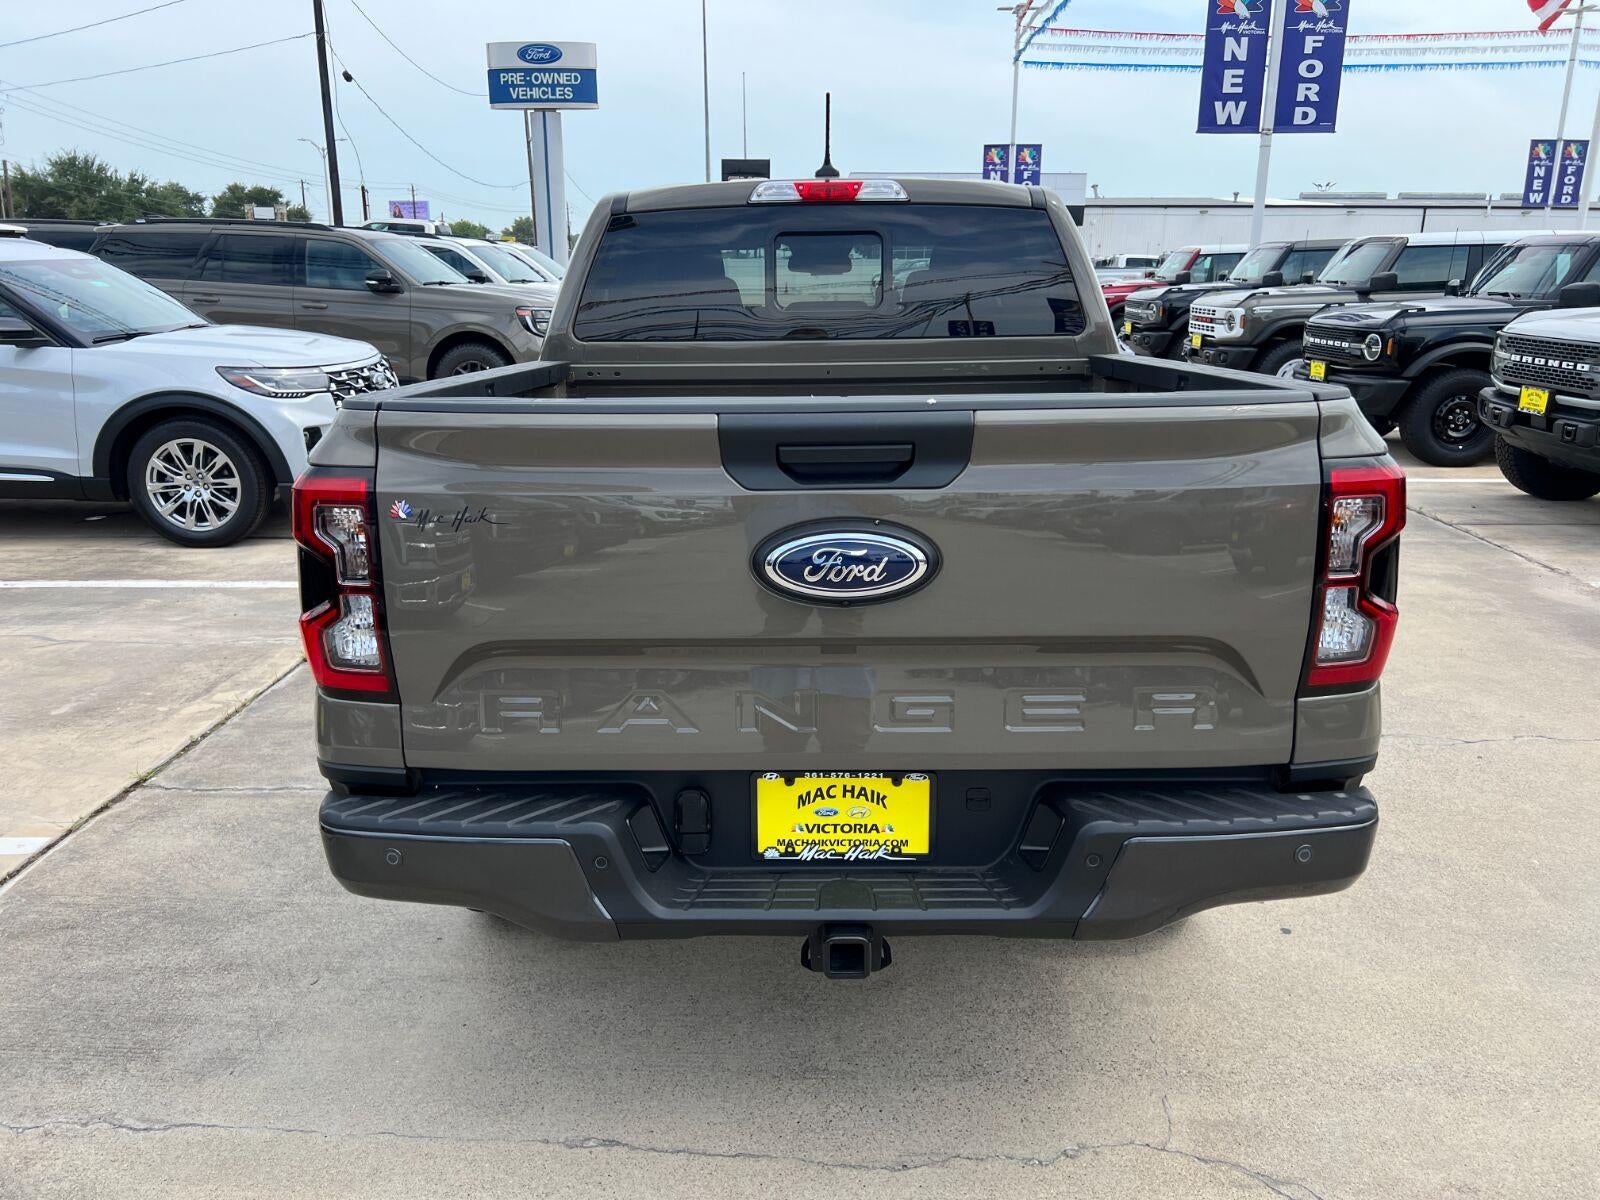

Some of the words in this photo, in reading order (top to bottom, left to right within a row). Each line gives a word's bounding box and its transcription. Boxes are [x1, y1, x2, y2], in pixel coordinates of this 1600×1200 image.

[1213, 21, 1238, 34] Mac
[1238, 20, 1263, 34] Haik
[1290, 20, 1316, 33] Mac
[1315, 19, 1341, 33] Haik
[525, 47, 552, 60] Ford
[1214, 36, 1249, 126] NEW
[1293, 35, 1325, 126] FORD
[509, 87, 574, 99] VEHICLES
[1528, 166, 1546, 204] NEW
[1560, 165, 1577, 204] FORD
[1309, 337, 1350, 348] BRONCO
[1511, 354, 1591, 372] BRONCO
[411, 509, 445, 532] Mac
[451, 506, 499, 532] Haik
[803, 547, 889, 583] Ford
[480, 686, 1220, 735] RANGER
[797, 784, 837, 810] MAC
[842, 784, 888, 810] HAIK
[817, 808, 836, 817] Ford
[804, 823, 881, 834] VICTORIA
[797, 845, 842, 861] Mac
[843, 845, 902, 861] Haik
